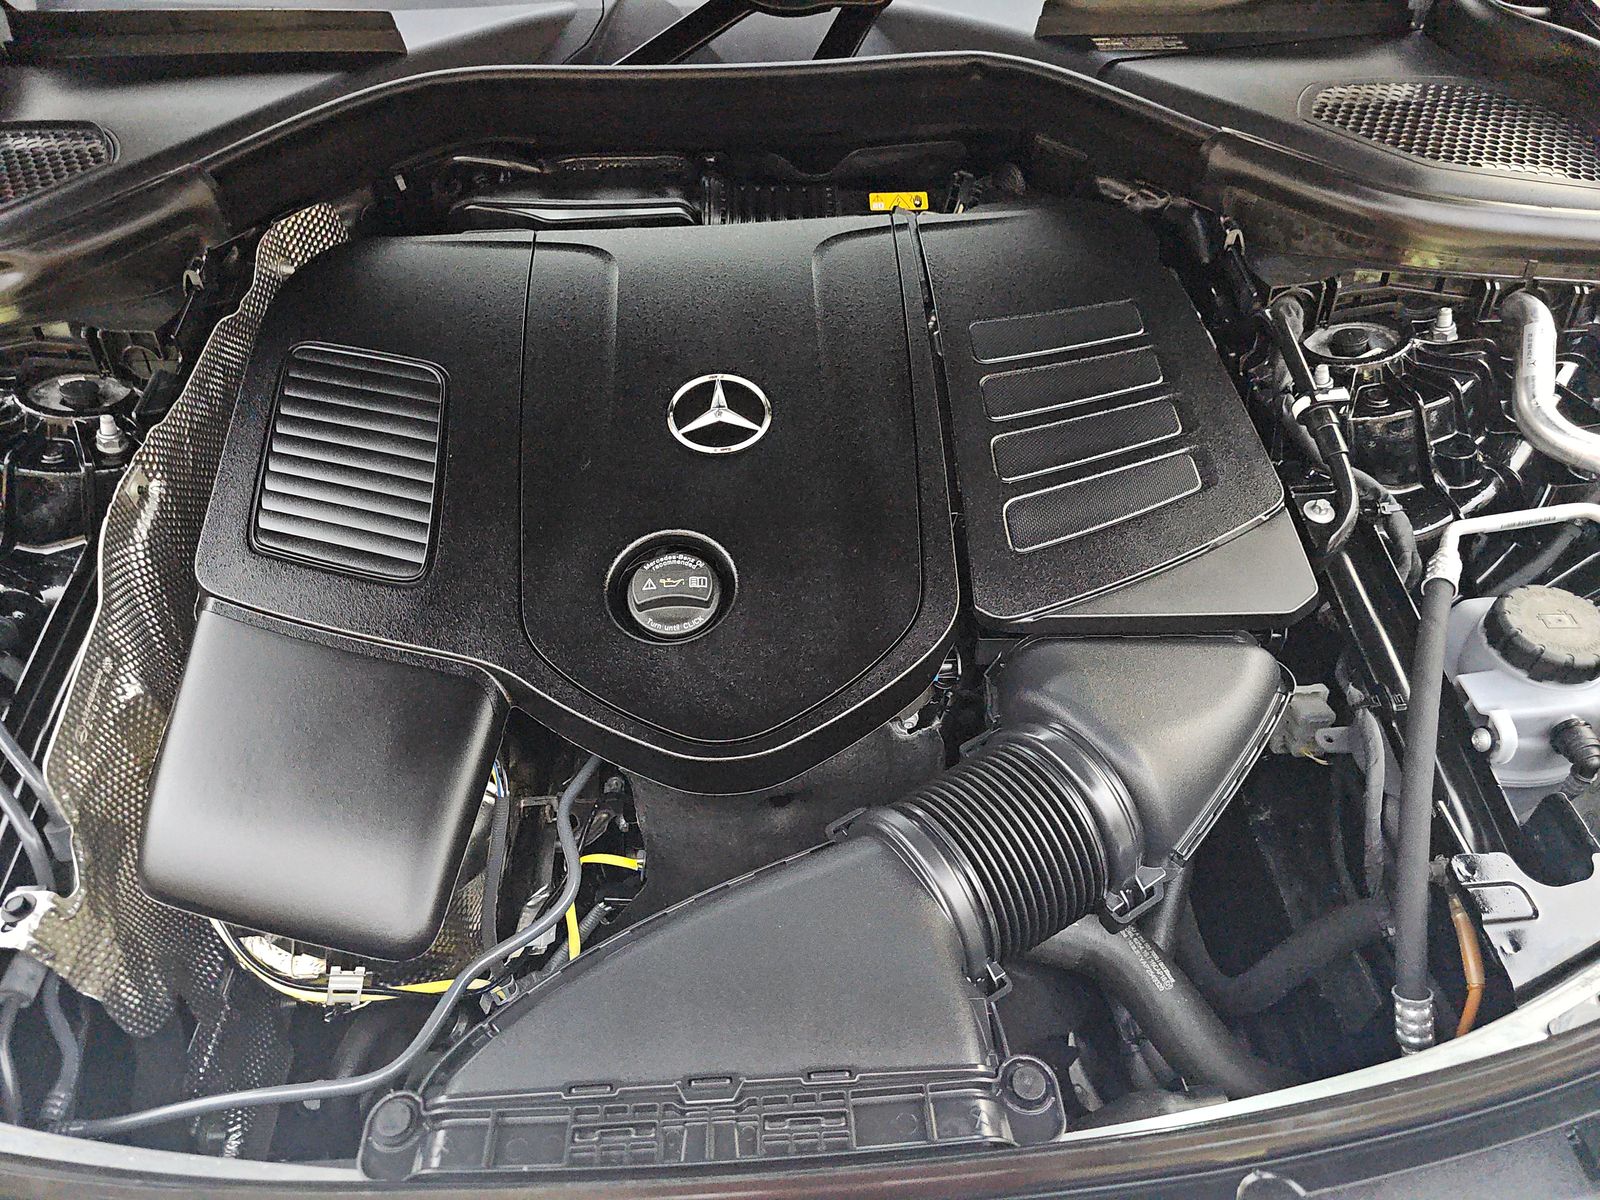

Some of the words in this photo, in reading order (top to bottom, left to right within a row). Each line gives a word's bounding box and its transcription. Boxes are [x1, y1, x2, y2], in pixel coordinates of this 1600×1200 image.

[643, 554, 696, 571] Mercedes-Benz
[696, 560, 705, 568] Oil
[652, 560, 697, 571] recommended
[647, 617, 662, 629] Turn
[683, 616, 705, 629] CLICK
